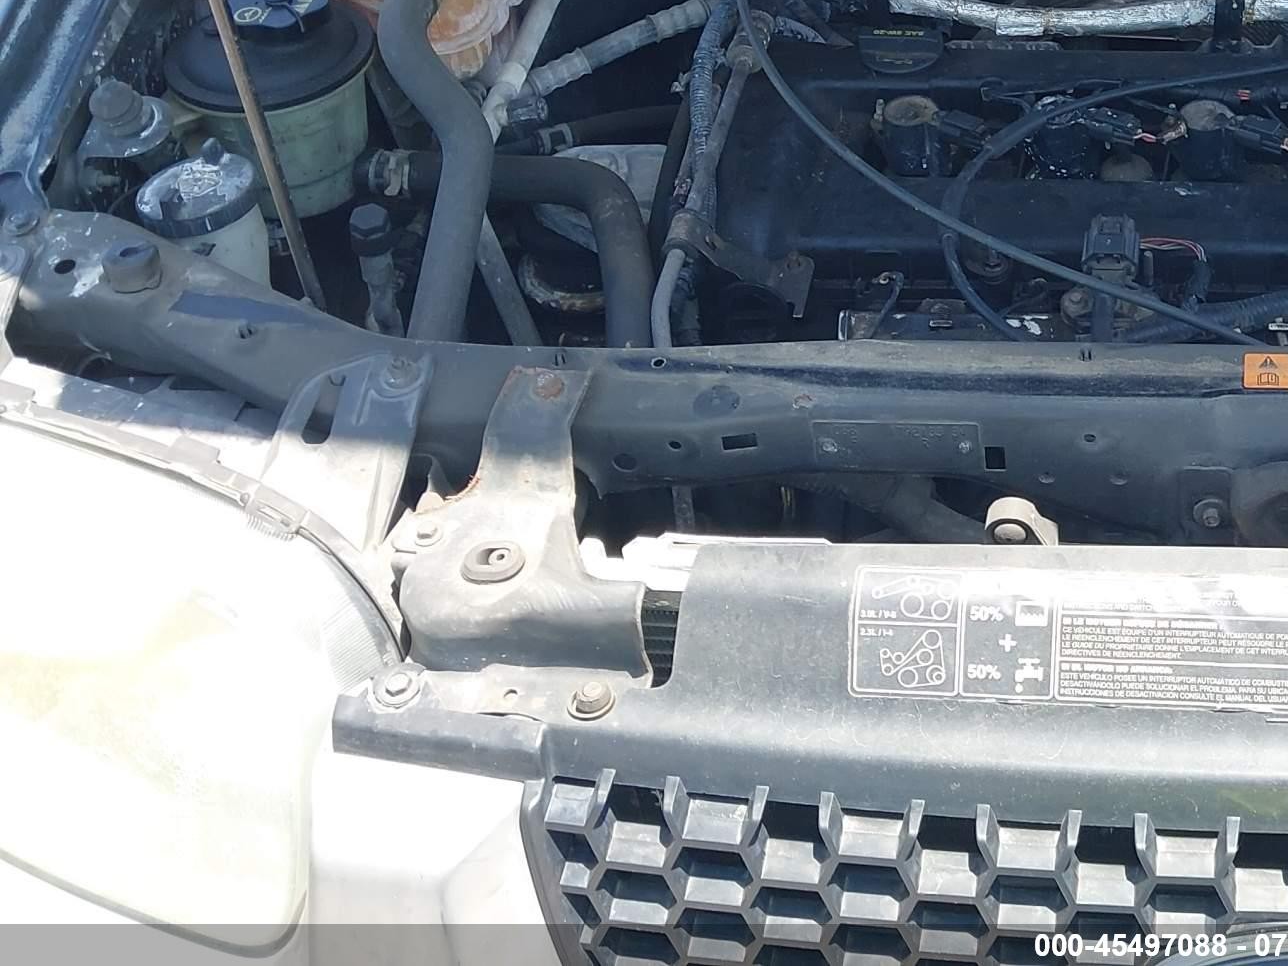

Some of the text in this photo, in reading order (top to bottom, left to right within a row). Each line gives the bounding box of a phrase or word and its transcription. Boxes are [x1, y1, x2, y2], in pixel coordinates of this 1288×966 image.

[970, 606, 1004, 622] 50%
[1164, 630, 1216, 638] INTERRUPTEUR
[1166, 637, 1217, 645] INTERRUPTEUR
[967, 665, 1001, 680] 50%
[1145, 683, 1188, 691] SOLUCIONAR
[1060, 688, 1113, 697] INSTRUCCIONES
[1179, 692, 1215, 700] CONSULTE
